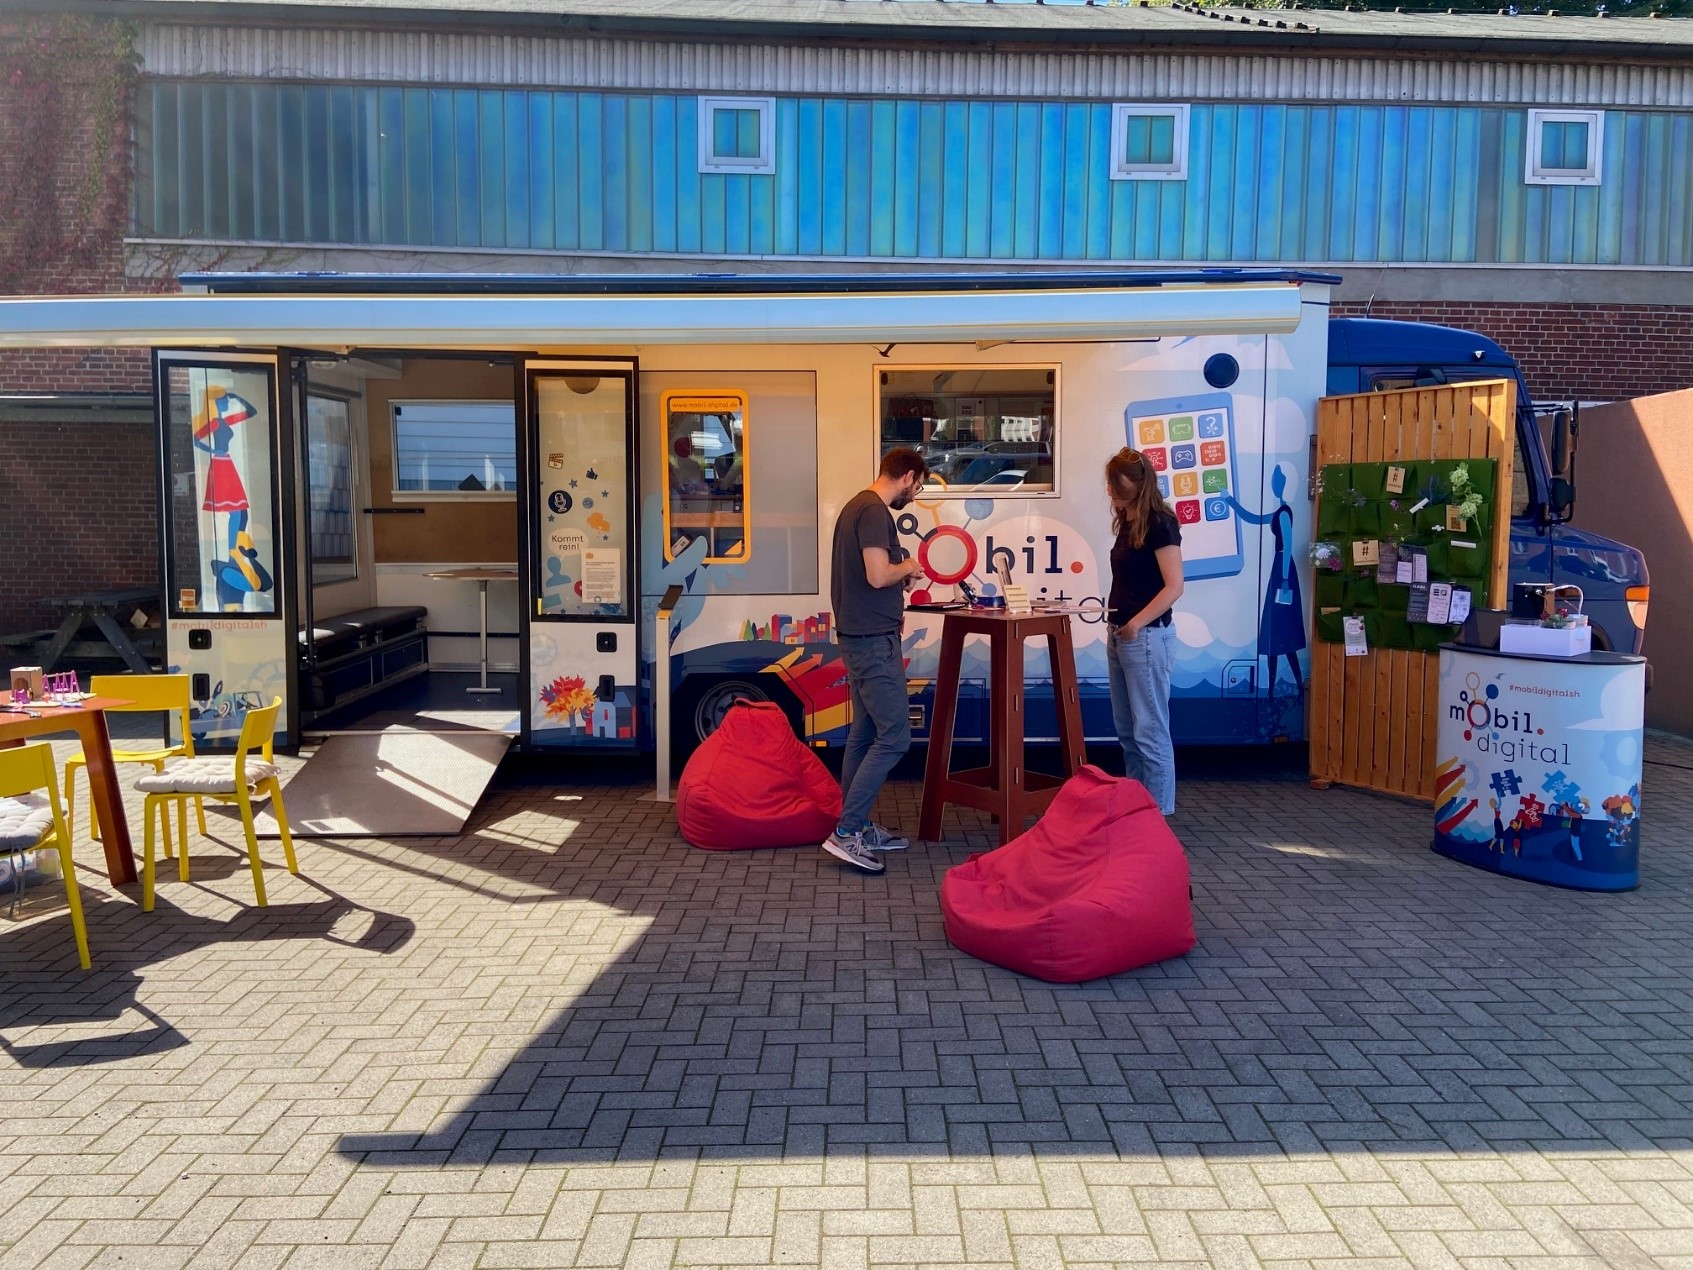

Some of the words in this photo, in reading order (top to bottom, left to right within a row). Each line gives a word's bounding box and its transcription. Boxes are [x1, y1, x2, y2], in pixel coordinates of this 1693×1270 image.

[551, 535, 584, 543] Kommt
[558, 543, 580, 551] rein!
[171, 620, 267, 631] #mobildigitalsh
[1509, 684, 1580, 698] #mobildigitalsh
[1477, 733, 1571, 765] digital
